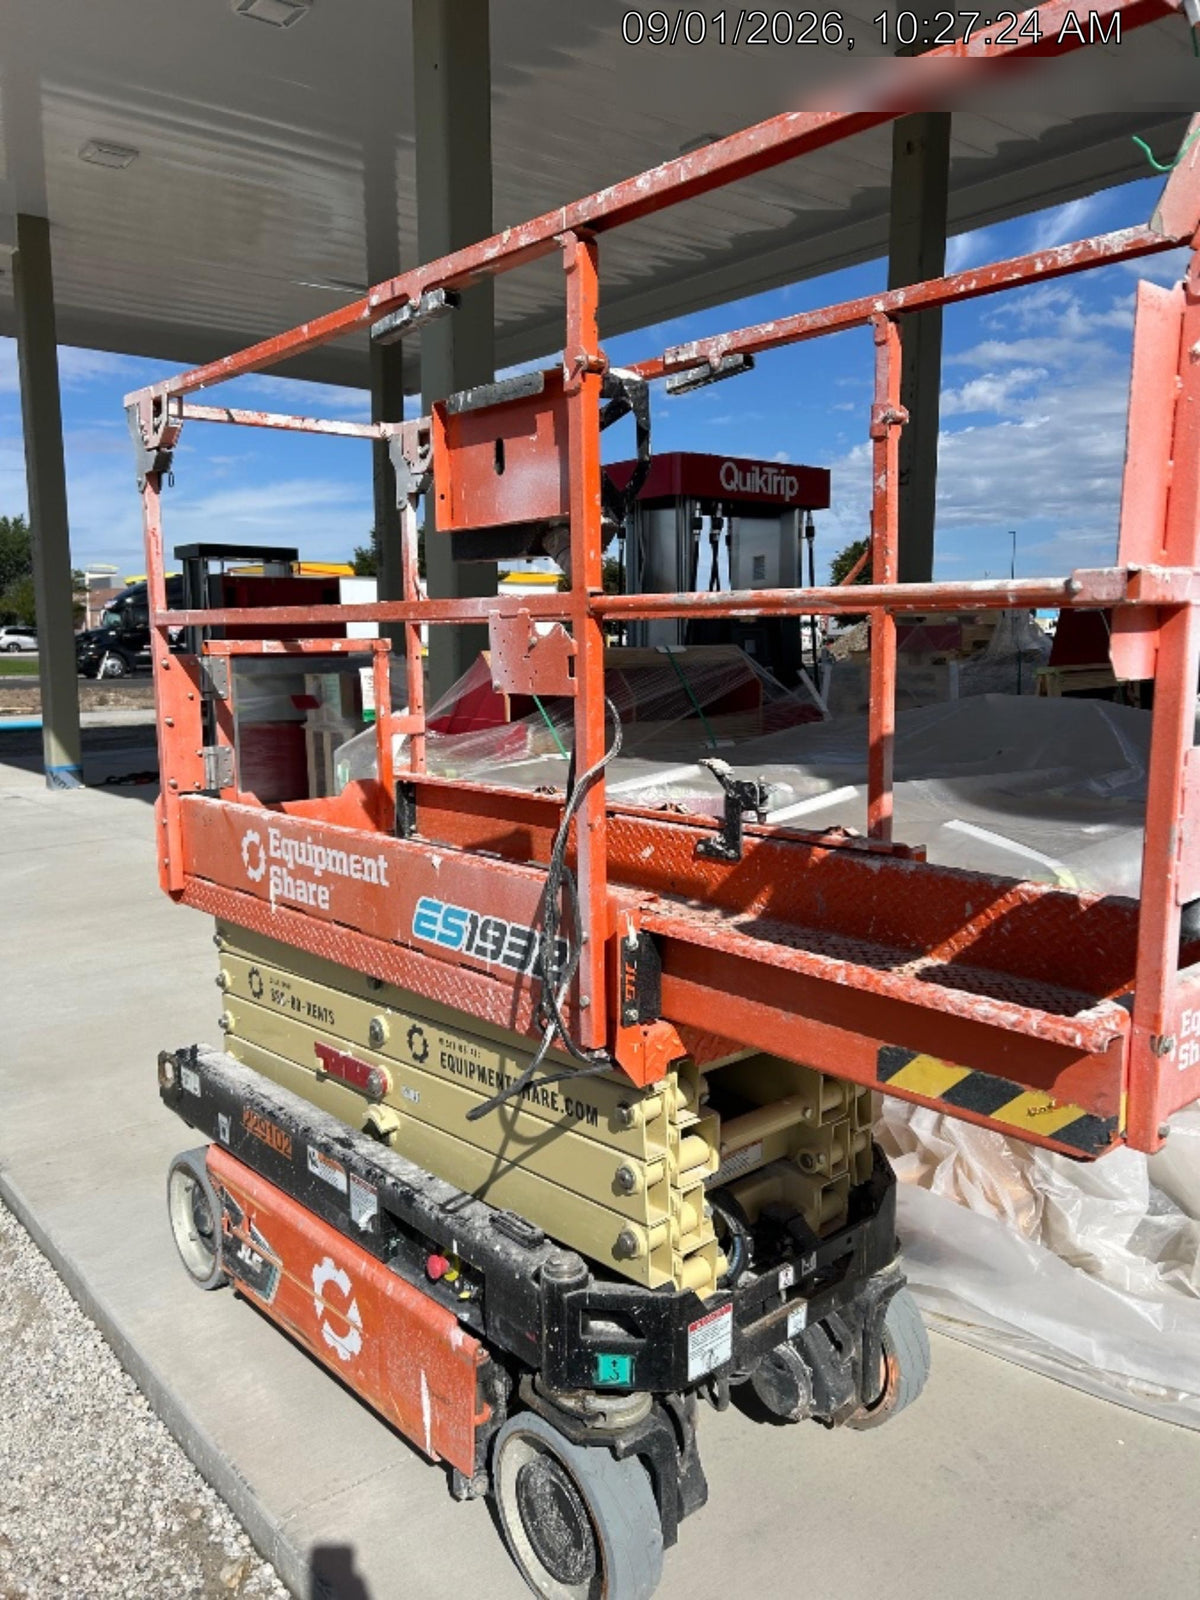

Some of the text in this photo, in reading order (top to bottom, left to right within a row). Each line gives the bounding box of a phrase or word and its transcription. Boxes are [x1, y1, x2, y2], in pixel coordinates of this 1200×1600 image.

[720, 461, 799, 502] QuikTrip
[268, 827, 390, 887] Equipment
[269, 865, 330, 910] Share
[440, 1052, 598, 1127] EQUIPMENTHARE.COM
